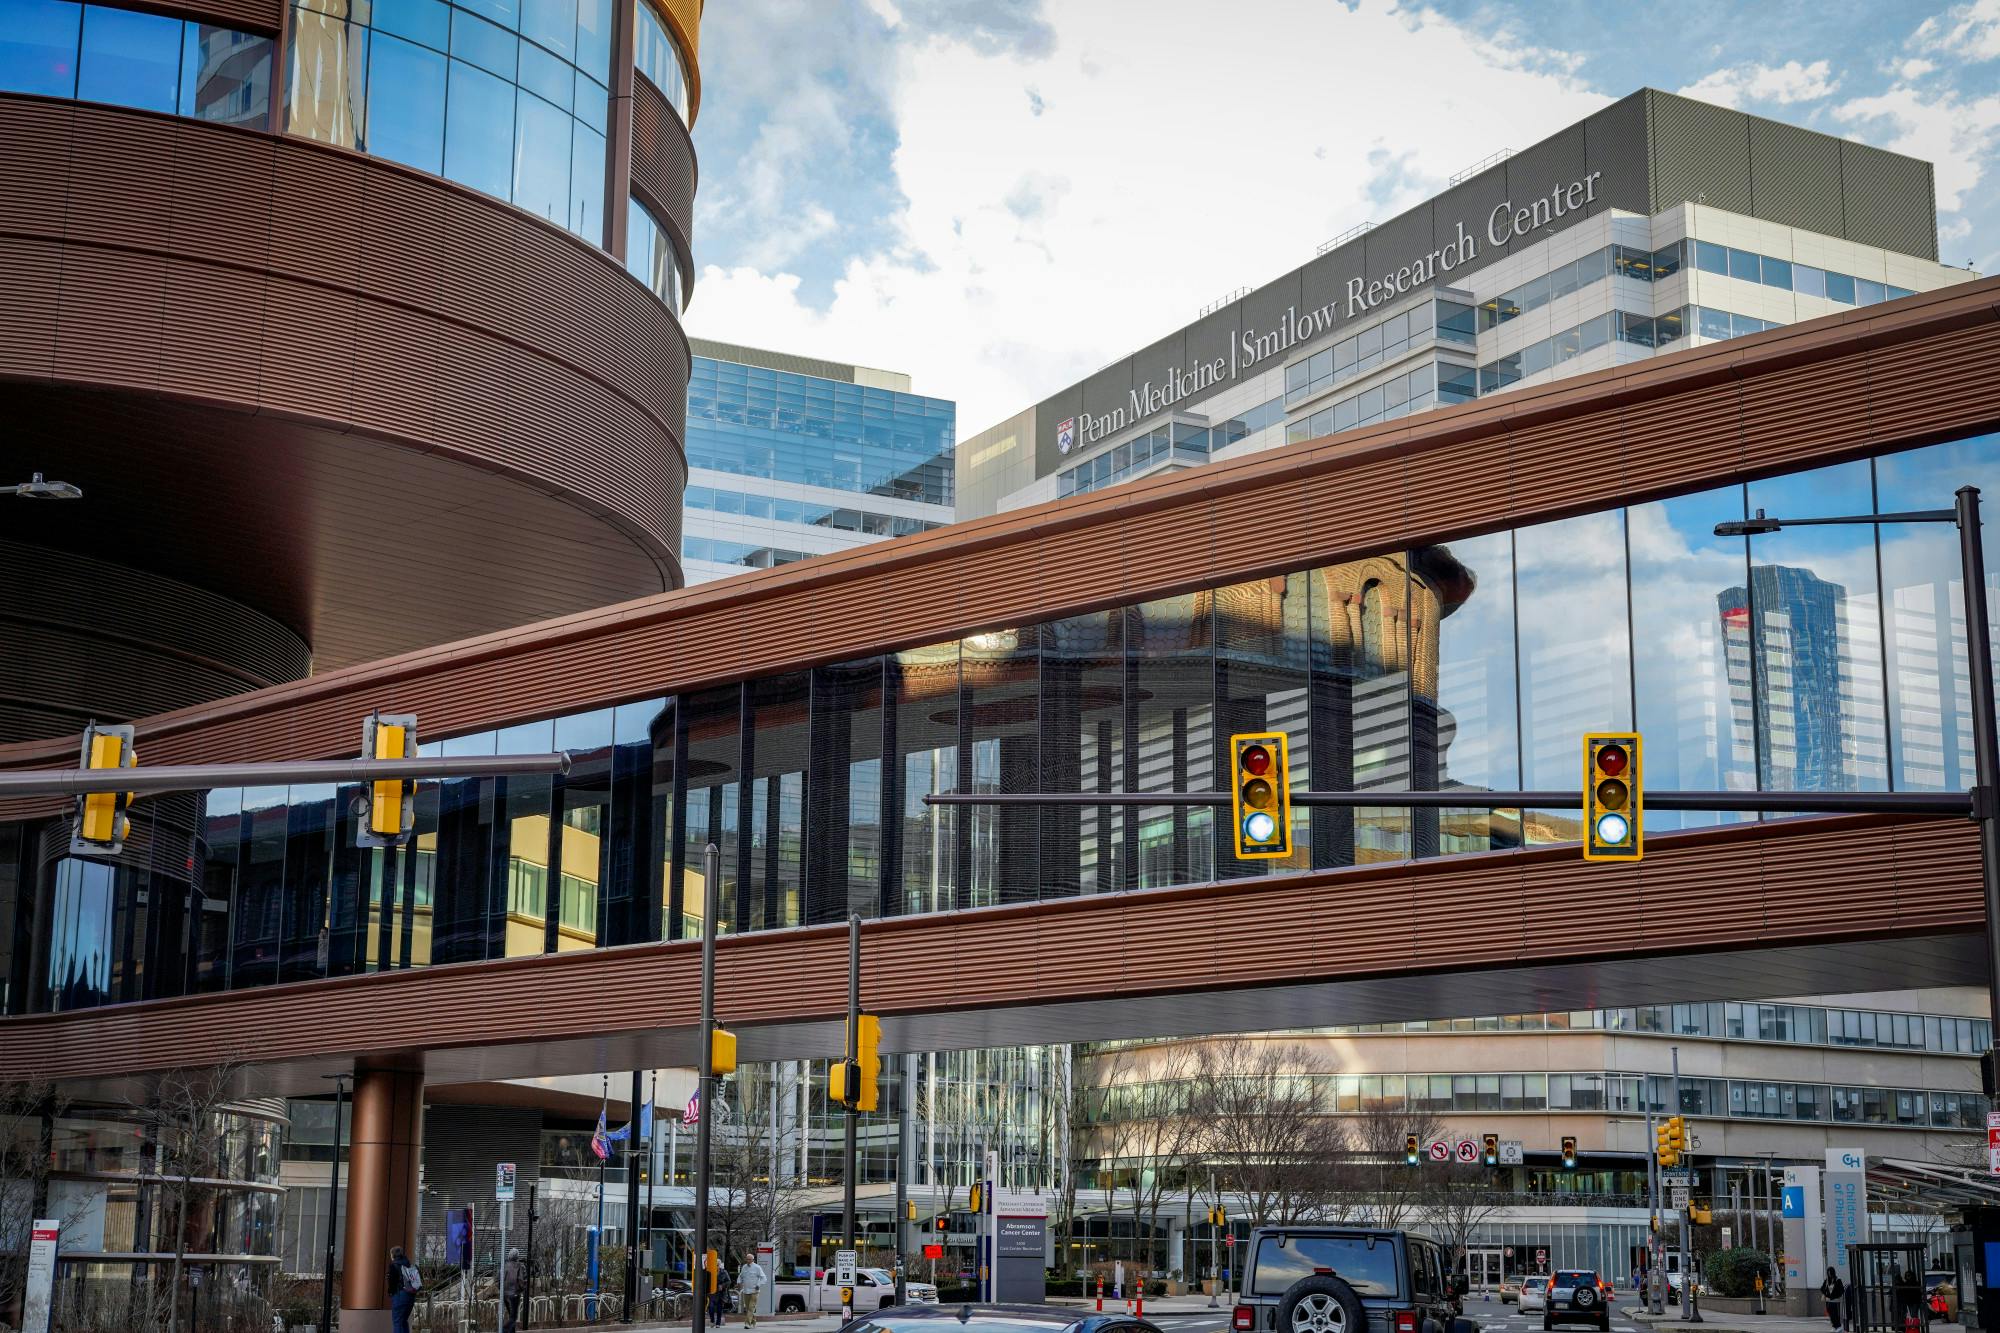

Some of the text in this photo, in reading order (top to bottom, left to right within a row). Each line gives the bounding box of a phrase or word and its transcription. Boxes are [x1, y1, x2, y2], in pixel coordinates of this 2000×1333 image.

[1078, 171, 1601, 448] Penn Medicine Smilow Research Center
[1784, 1194, 1793, 1210] A
[1834, 1199, 1846, 1266] Philadelphia
